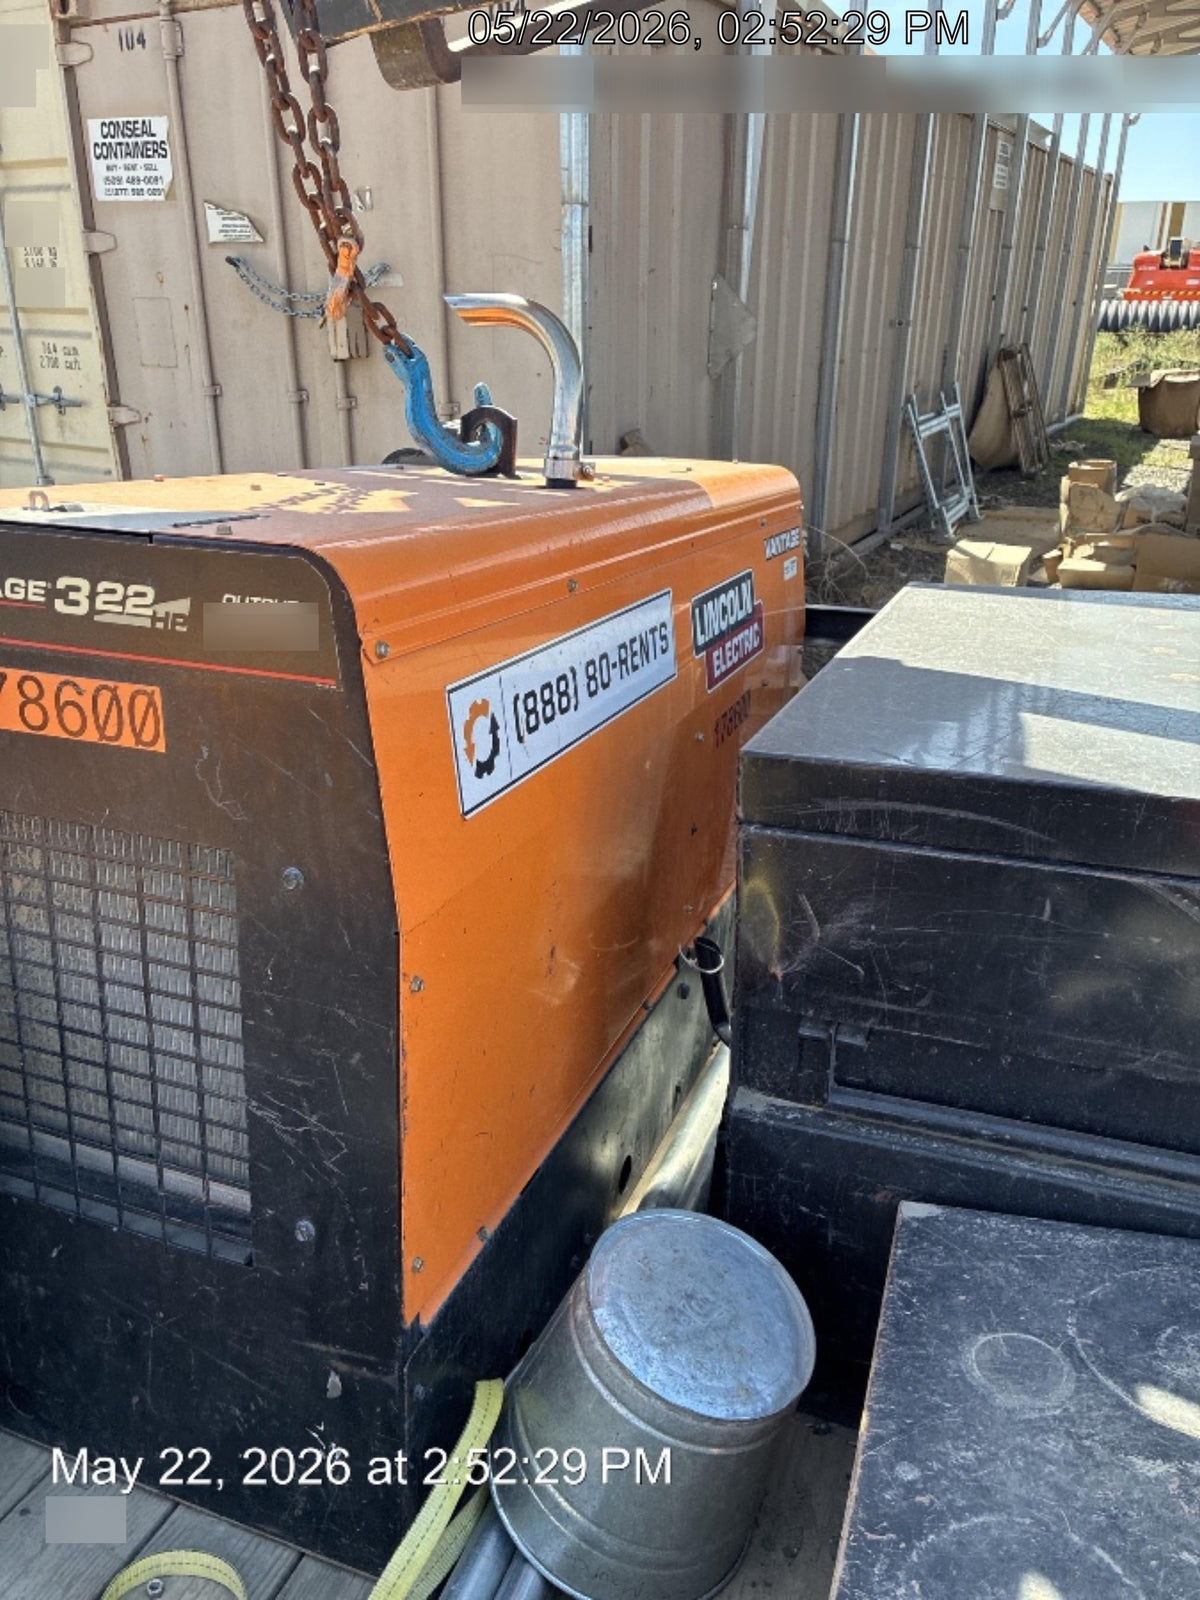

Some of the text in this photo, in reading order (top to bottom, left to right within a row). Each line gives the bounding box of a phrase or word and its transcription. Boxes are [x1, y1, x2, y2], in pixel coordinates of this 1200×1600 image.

[93, 140, 168, 160] CONTAINERS
[100, 119, 157, 139] CONSEAL
[55, 575, 156, 617] 322
[694, 579, 753, 646] LINCOLN
[712, 622, 760, 678] ELECTRIC
[513, 621, 670, 744] (888) 80-RENTS
